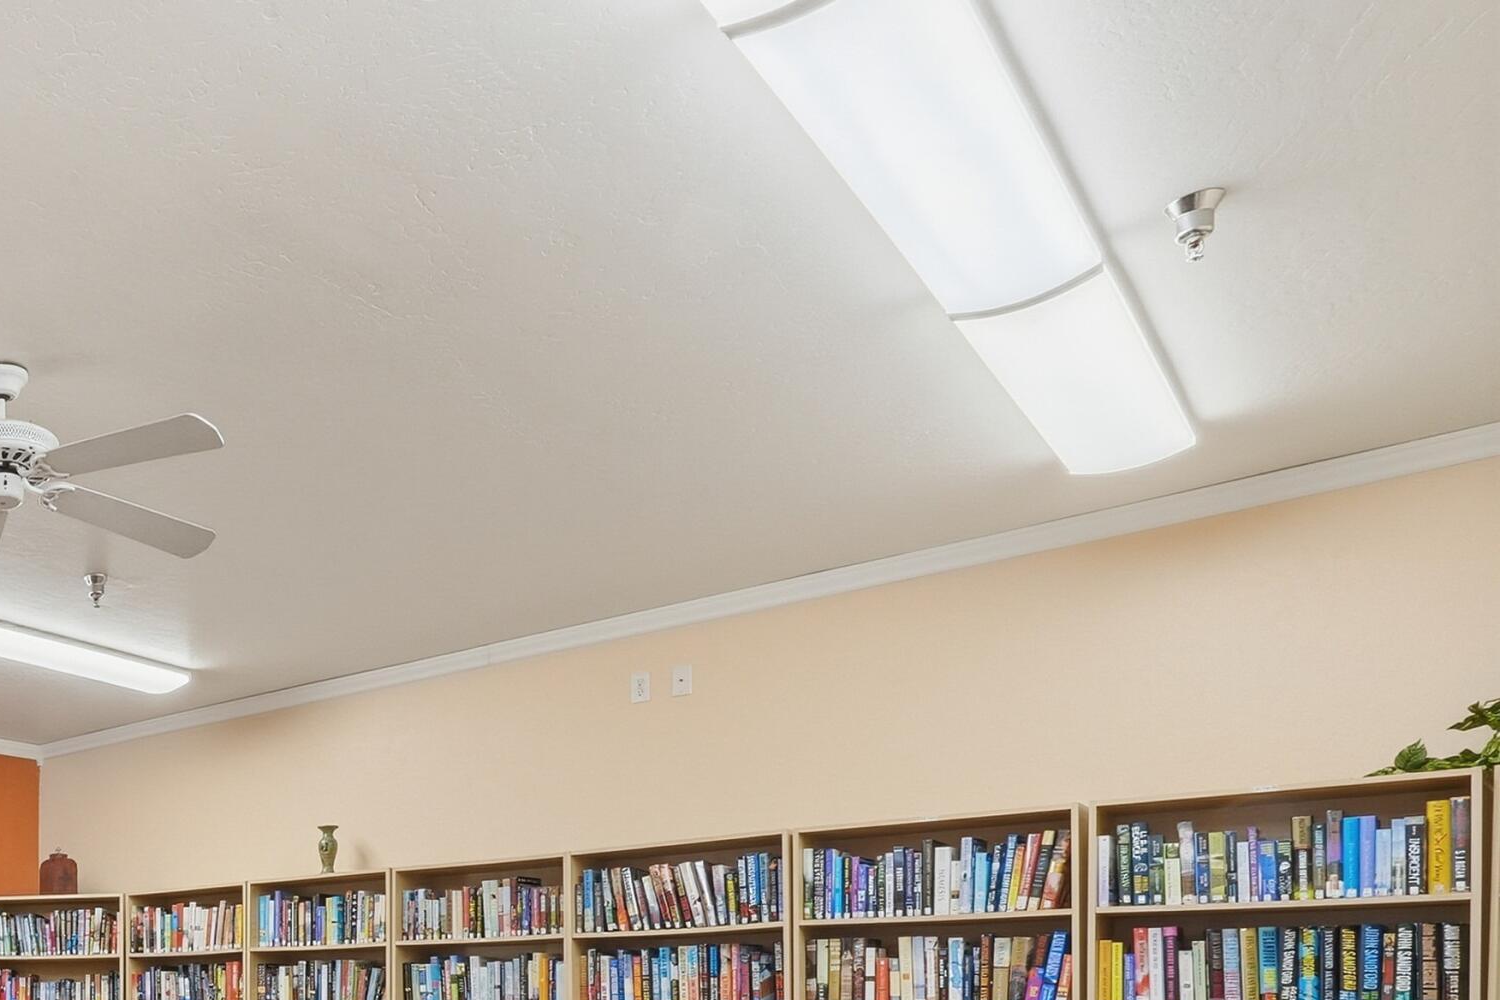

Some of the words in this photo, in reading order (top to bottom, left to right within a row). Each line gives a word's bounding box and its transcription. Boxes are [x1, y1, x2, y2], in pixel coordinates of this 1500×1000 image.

[1408, 837, 1421, 886] INSURGENT
[938, 869, 946, 902] NEMESIS
[1342, 929, 1356, 950] JOHN
[1365, 926, 1380, 948] JOHN
[1397, 928, 1413, 950] JOHN
[1342, 951, 1357, 990] SANDFORD
[1363, 948, 1380, 990] SANDFORD
[1396, 951, 1412, 992] SANDFORD
